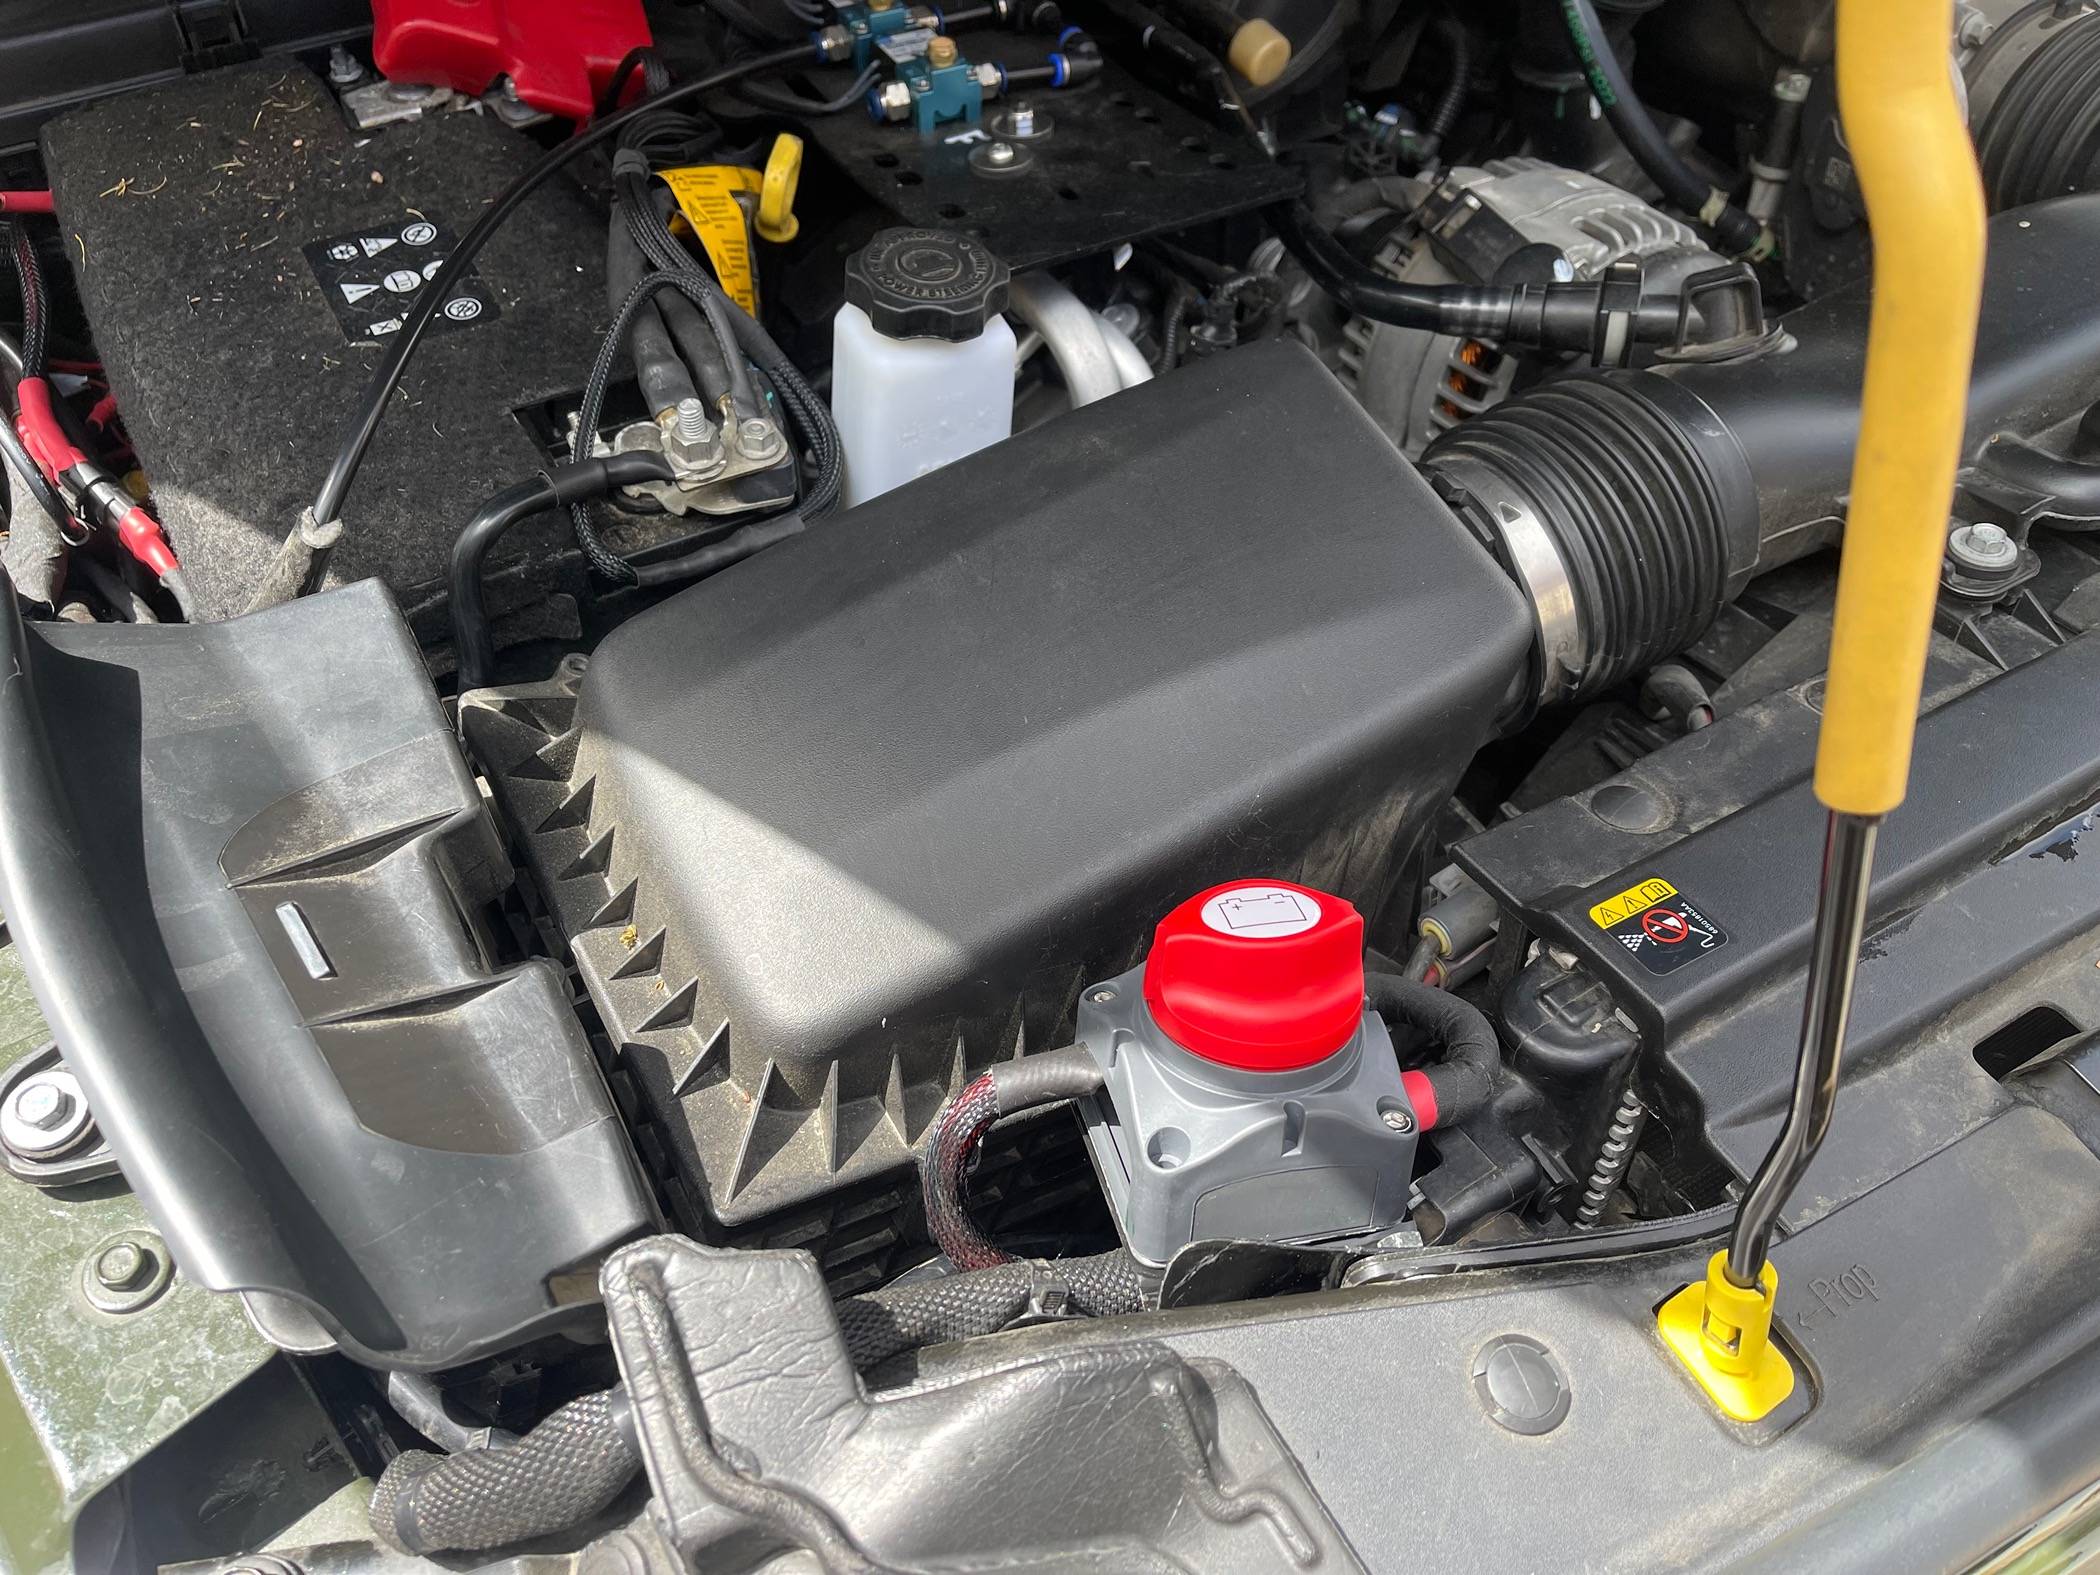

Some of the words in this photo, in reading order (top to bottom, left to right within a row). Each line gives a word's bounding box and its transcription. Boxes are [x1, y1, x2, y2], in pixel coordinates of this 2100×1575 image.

[878, 273, 924, 297] POWER
[927, 272, 985, 299] STEERING
[1807, 1263, 1880, 1318] Prop
